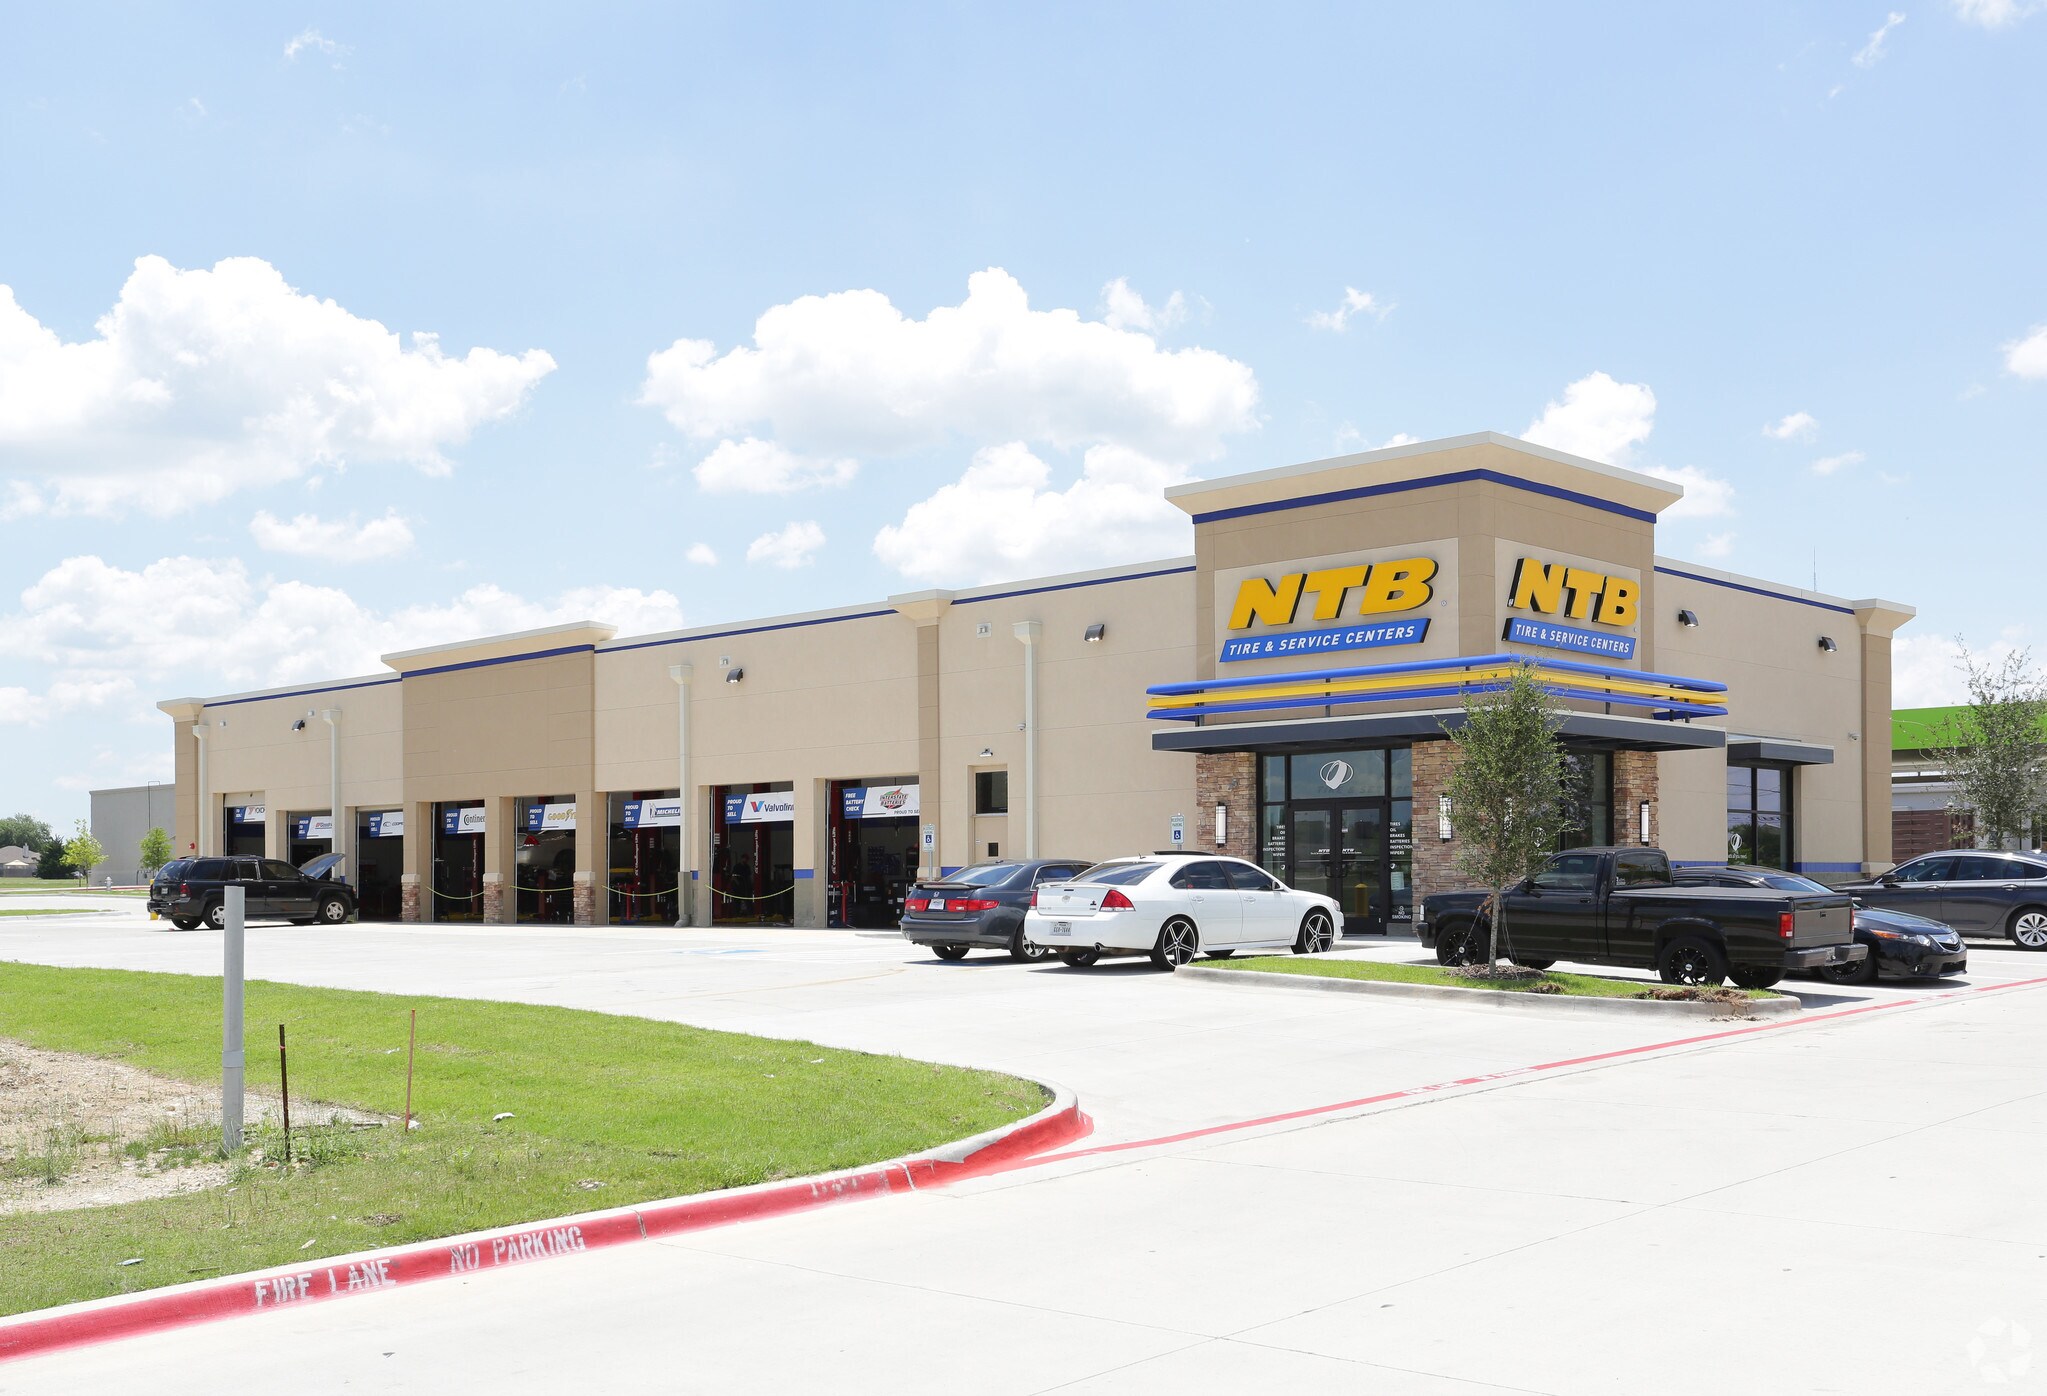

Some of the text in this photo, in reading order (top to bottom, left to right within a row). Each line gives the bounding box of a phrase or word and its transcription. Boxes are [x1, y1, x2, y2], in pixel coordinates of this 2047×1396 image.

[1227, 557, 1439, 630] NTB
[1507, 557, 1640, 627] NTB
[1229, 625, 1415, 656] TIRE & SERVICE CENTERS
[1515, 624, 1630, 653] TIRE & SERVICE CENTERS
[255, 1224, 587, 1307] FIRE LANE NO PARKING
